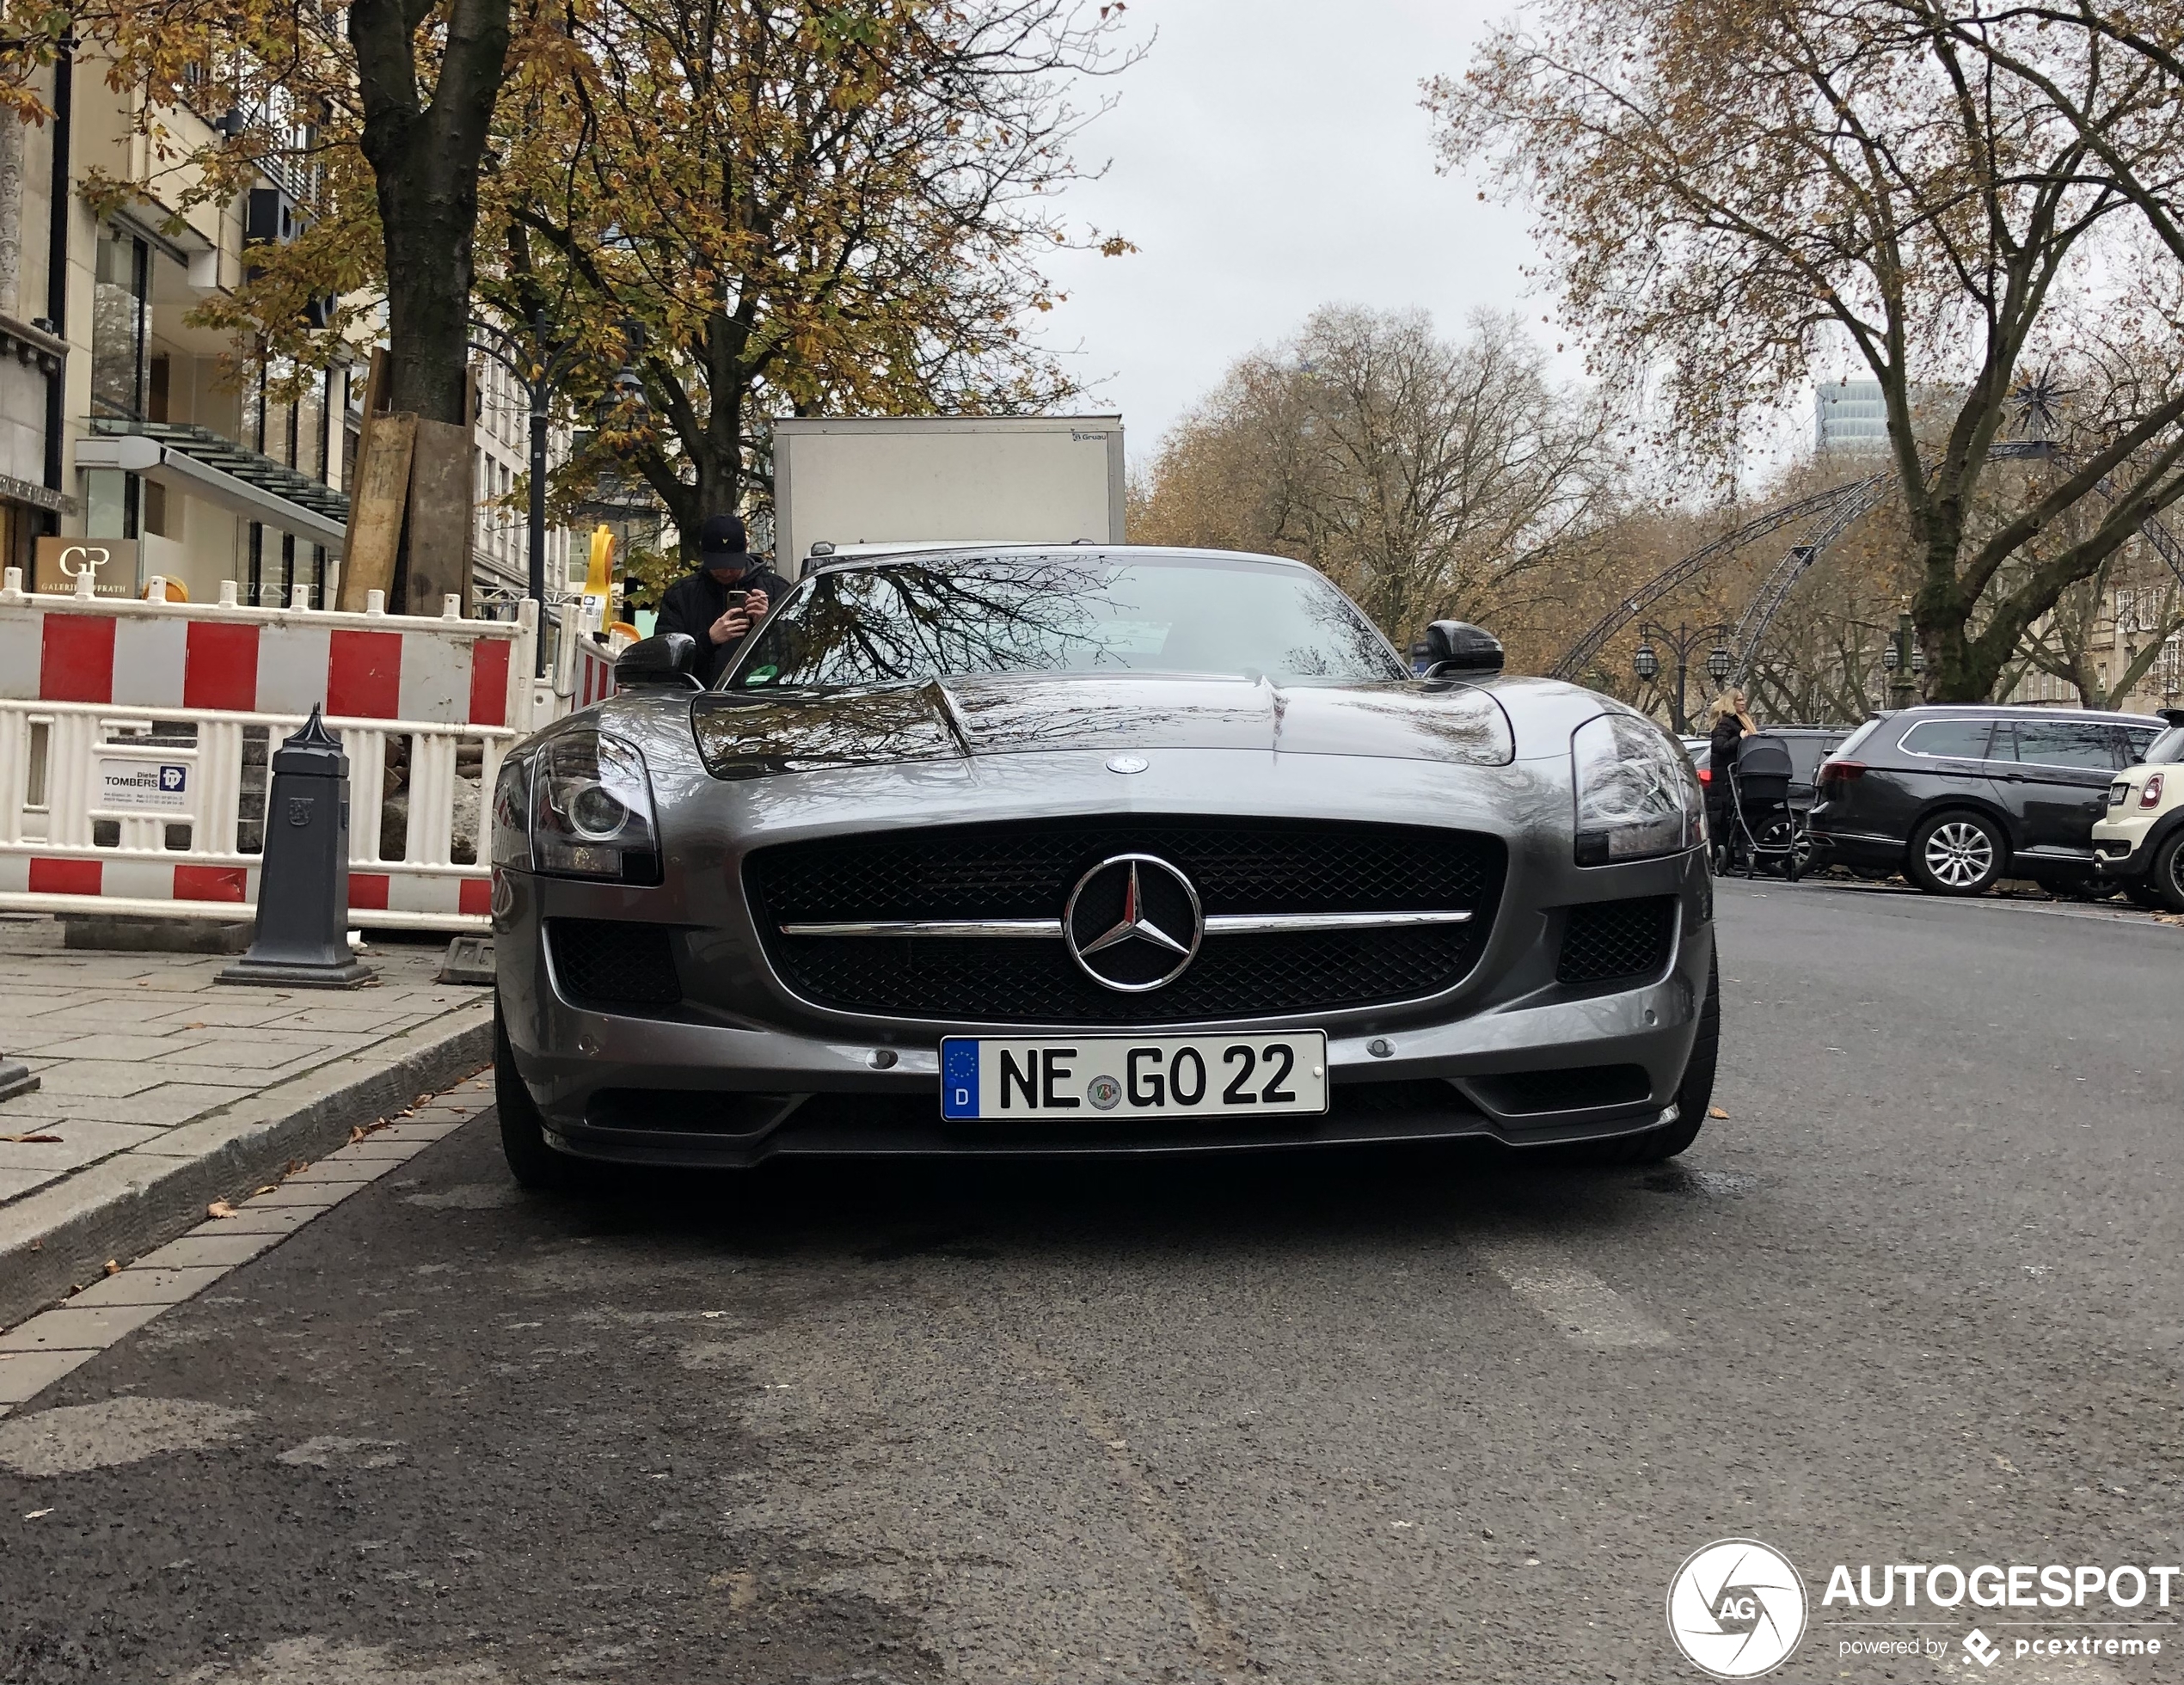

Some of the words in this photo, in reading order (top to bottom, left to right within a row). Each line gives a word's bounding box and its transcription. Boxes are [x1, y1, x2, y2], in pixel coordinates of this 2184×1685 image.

[59, 546, 110, 577] GP
[105, 776, 158, 787] TOMBERS
[955, 1088, 969, 1106] D
[1000, 1048, 1081, 1109] NE
[1127, 1046, 1206, 1106] GO
[1224, 1044, 1296, 1104] 22
